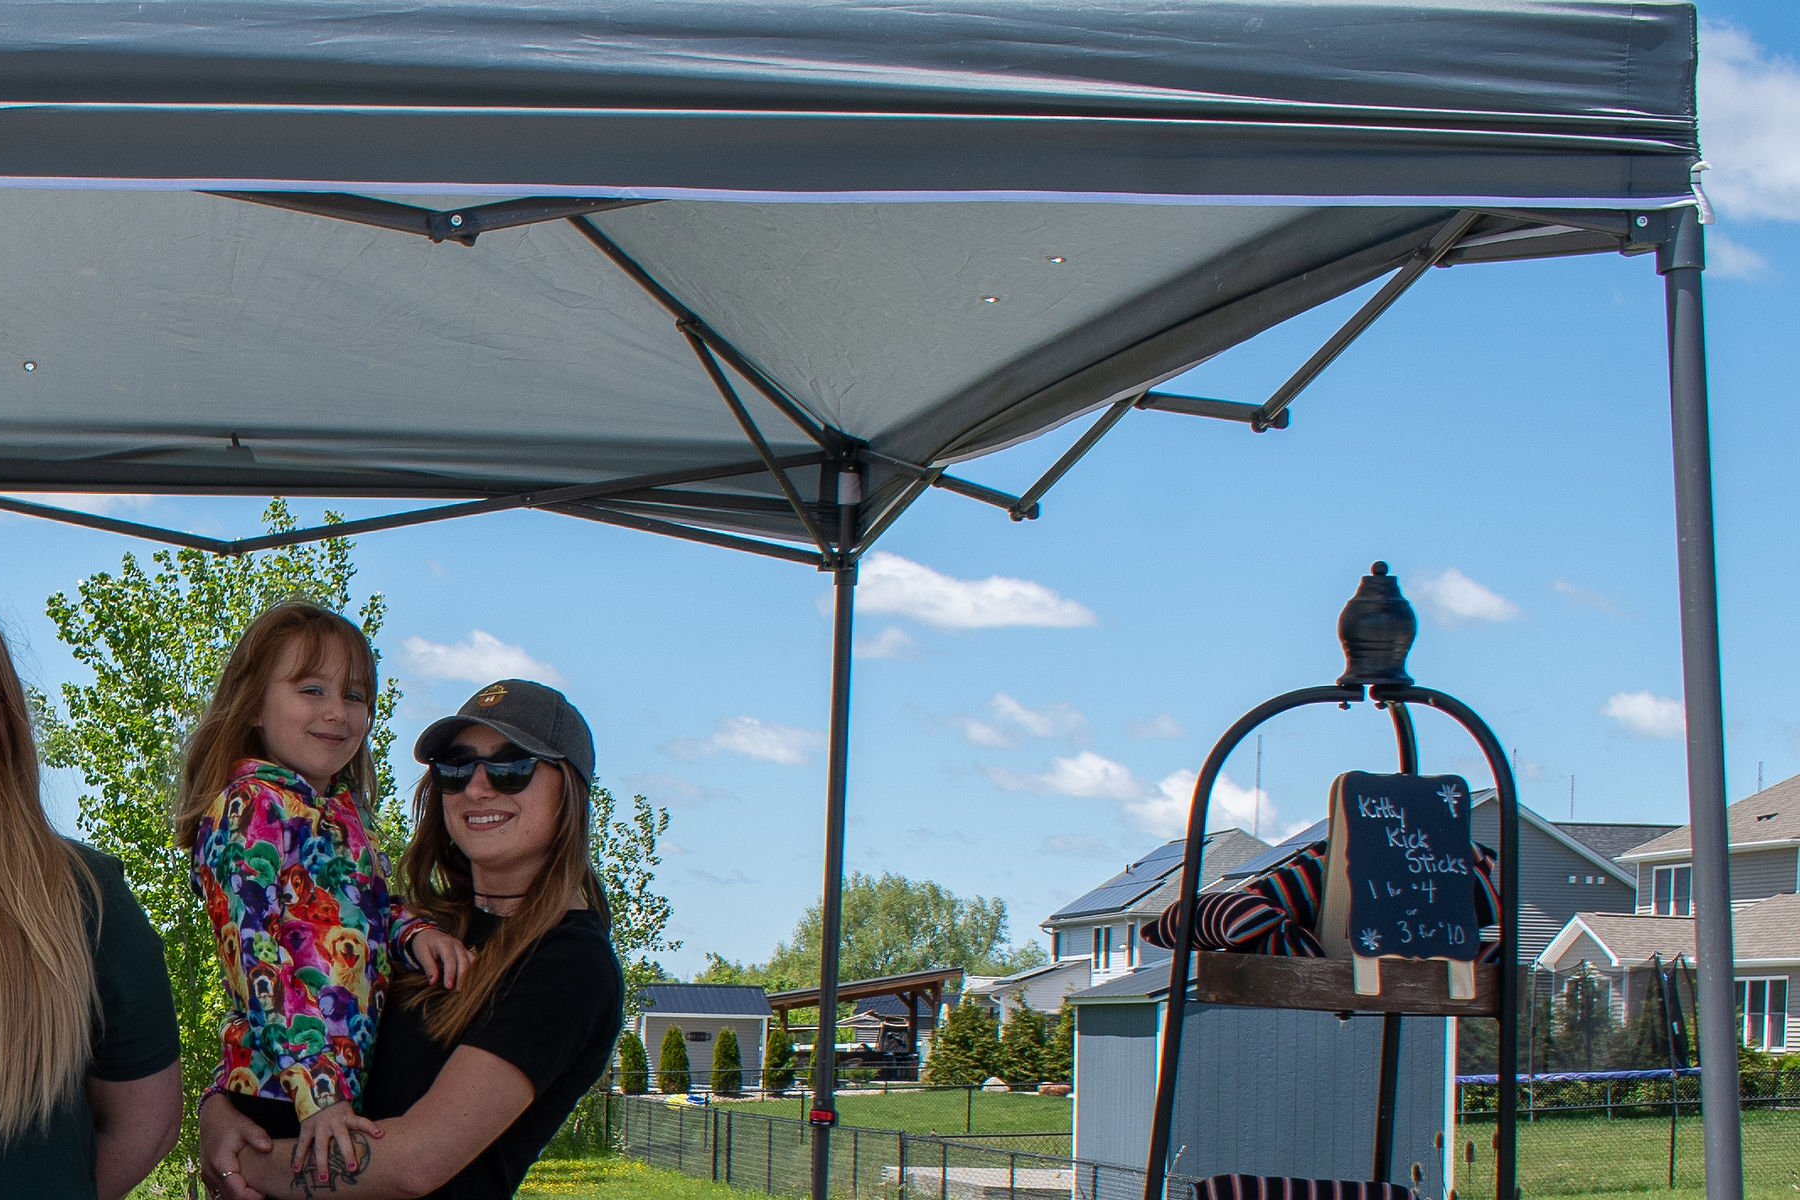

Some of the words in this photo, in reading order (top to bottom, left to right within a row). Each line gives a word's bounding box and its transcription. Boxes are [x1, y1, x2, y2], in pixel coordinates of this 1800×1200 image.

[1357, 794, 1405, 828] Kitty
[1385, 826, 1430, 849] Kick
[1405, 849, 1468, 875] Sticks
[1367, 879, 1378, 900] 1
[1398, 920, 1412, 944] 3
